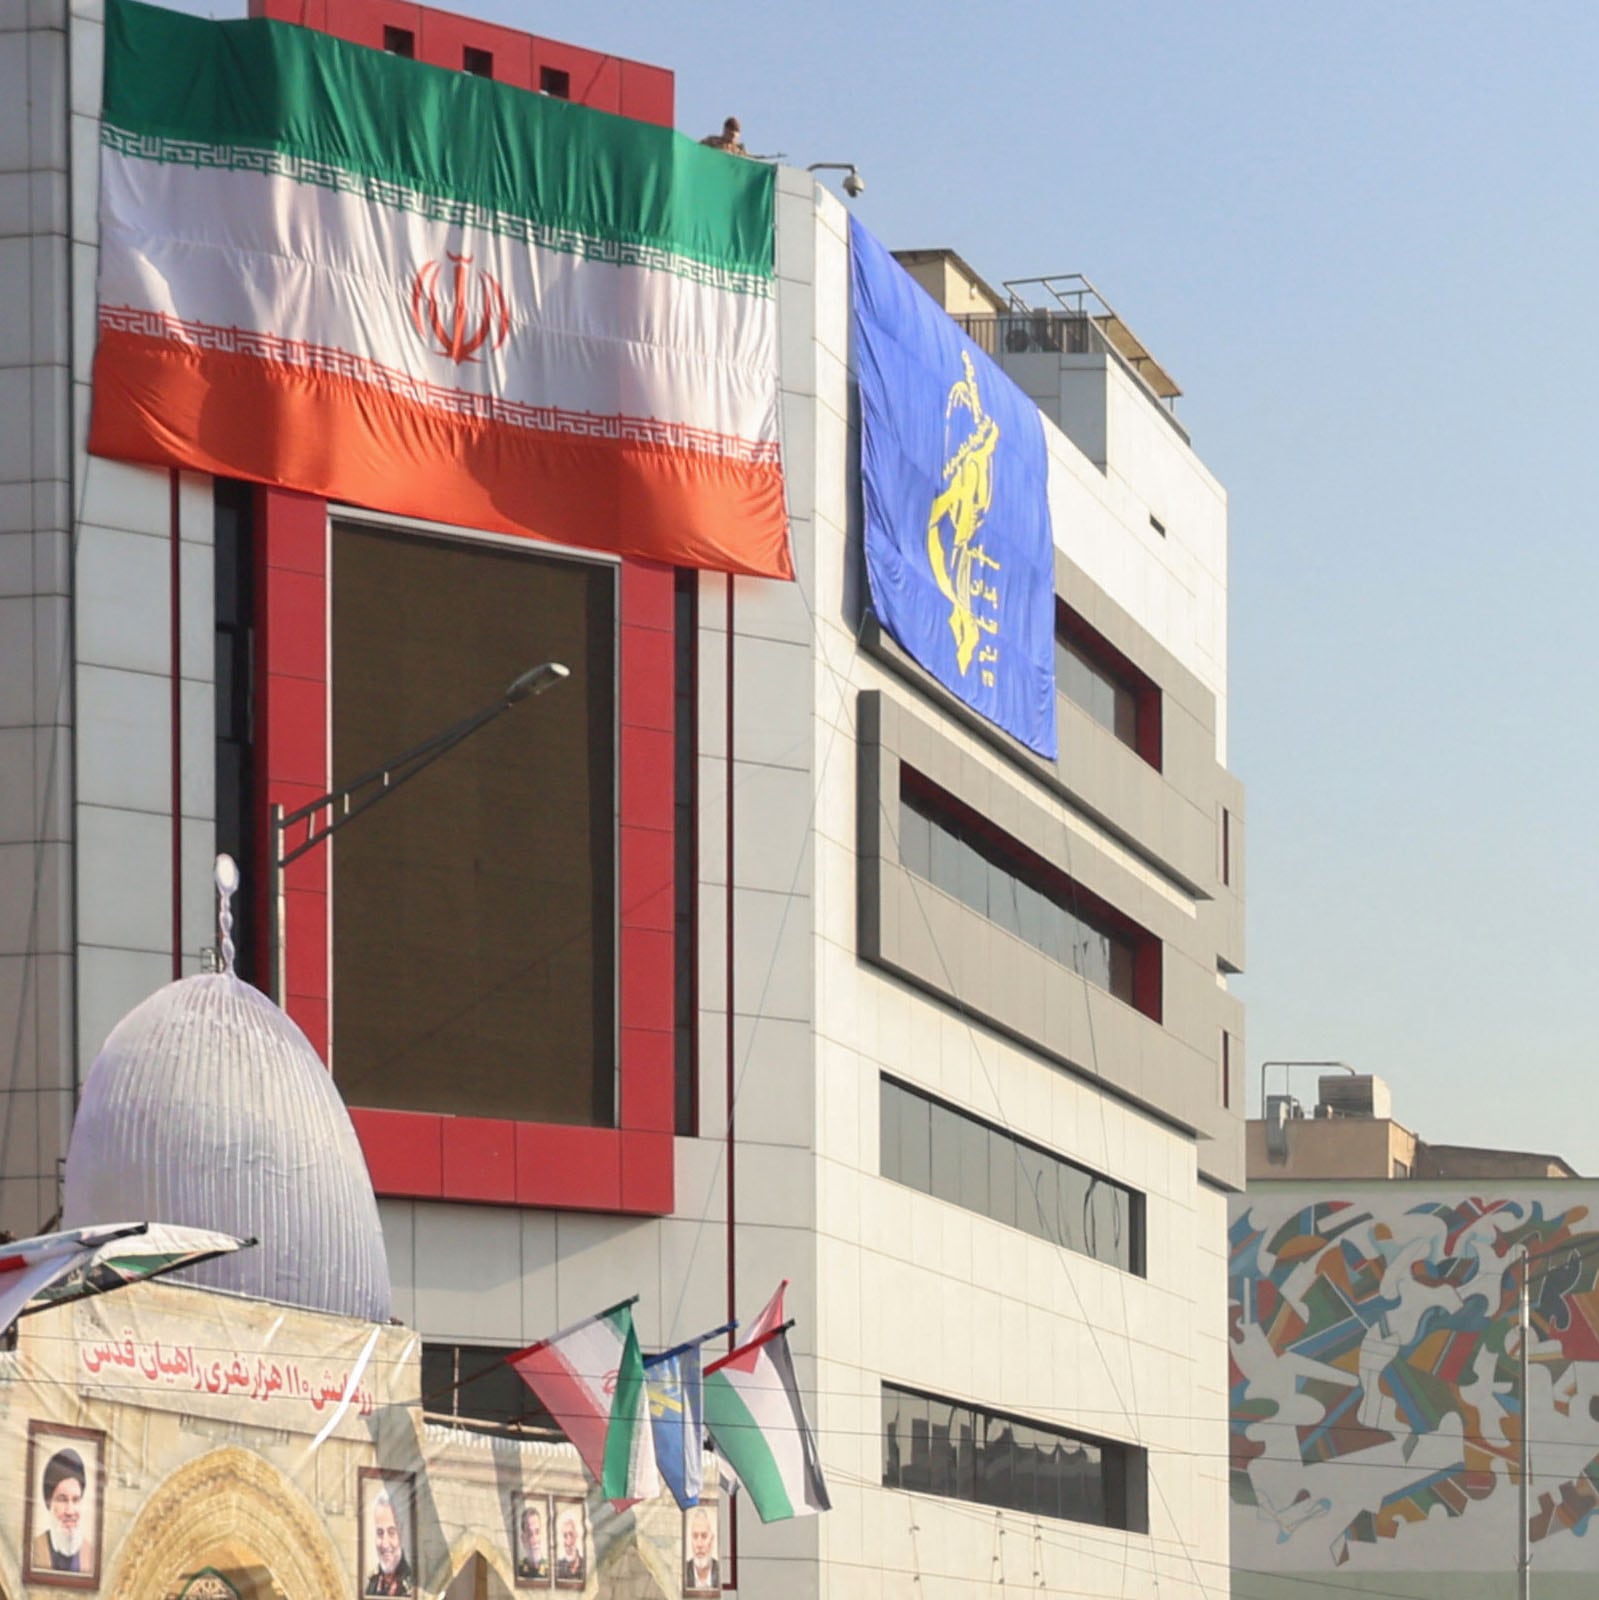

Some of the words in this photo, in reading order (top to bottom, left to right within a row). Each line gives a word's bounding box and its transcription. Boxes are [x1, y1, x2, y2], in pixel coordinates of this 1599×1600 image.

[82, 1329, 137, 1373] قدس
[139, 1340, 202, 1390] راهیان
[205, 1352, 250, 1394] نفری
[250, 1359, 283, 1401] هزار
